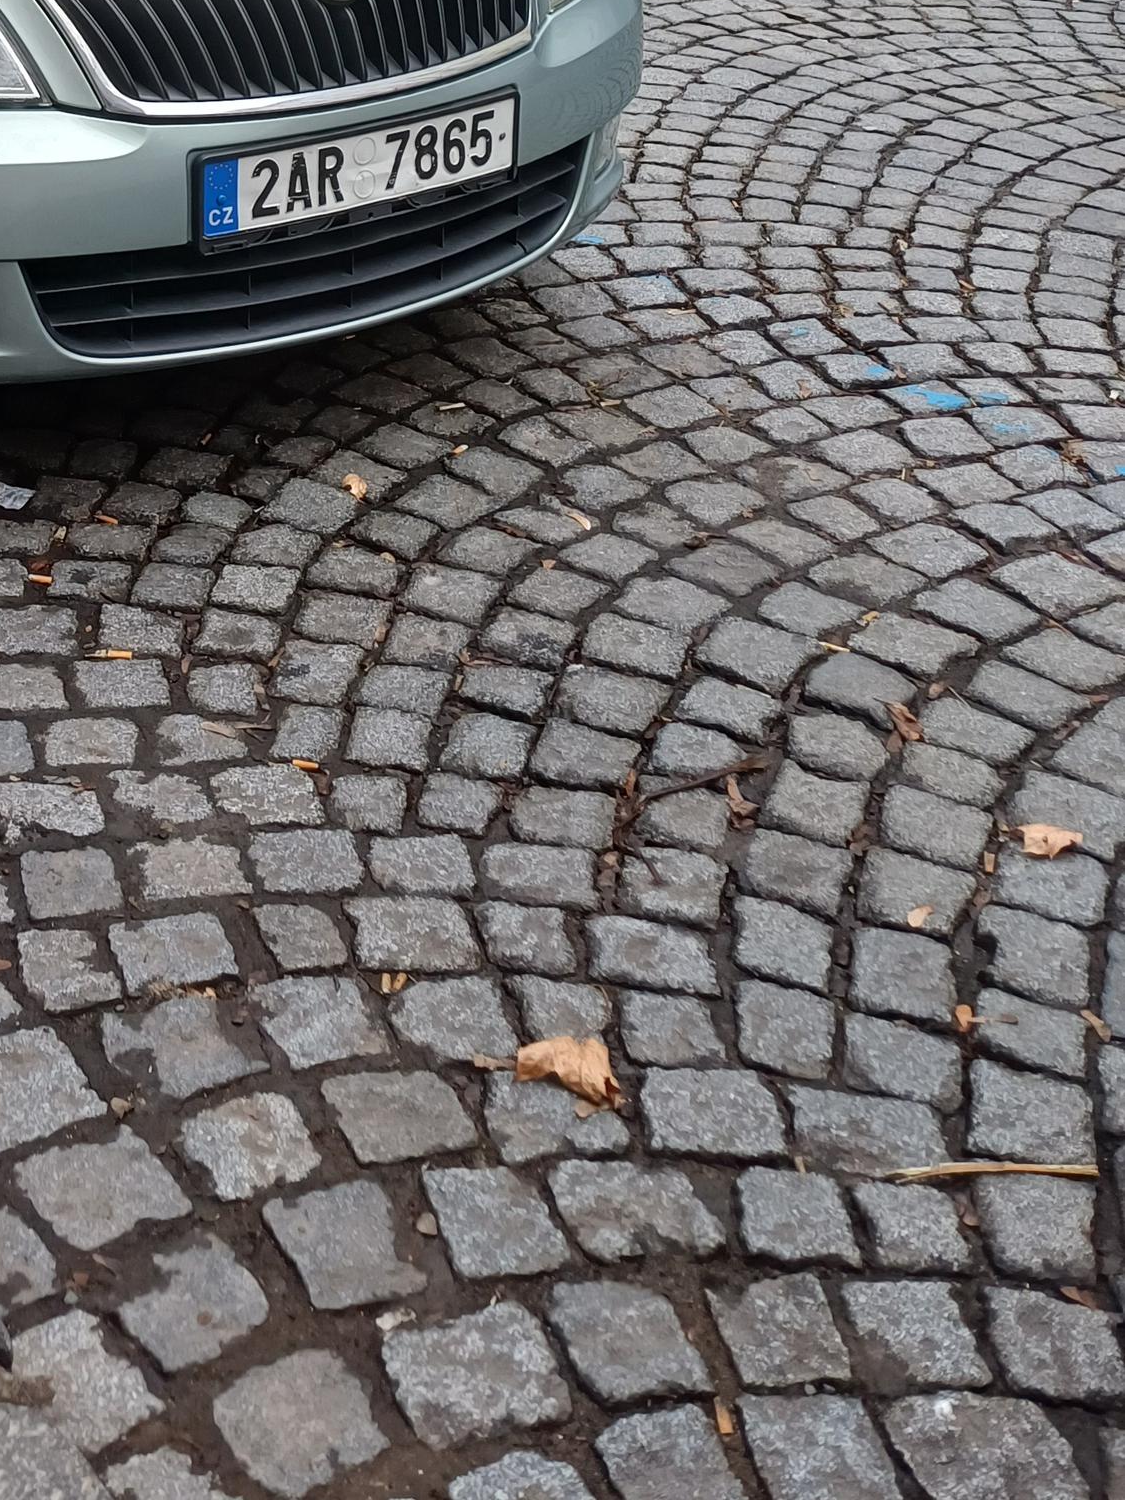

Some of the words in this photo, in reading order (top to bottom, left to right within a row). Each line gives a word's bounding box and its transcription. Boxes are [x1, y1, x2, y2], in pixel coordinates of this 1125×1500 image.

[250, 146, 345, 220] 2AR
[384, 109, 495, 192] 7865
[208, 206, 235, 227] CZ
